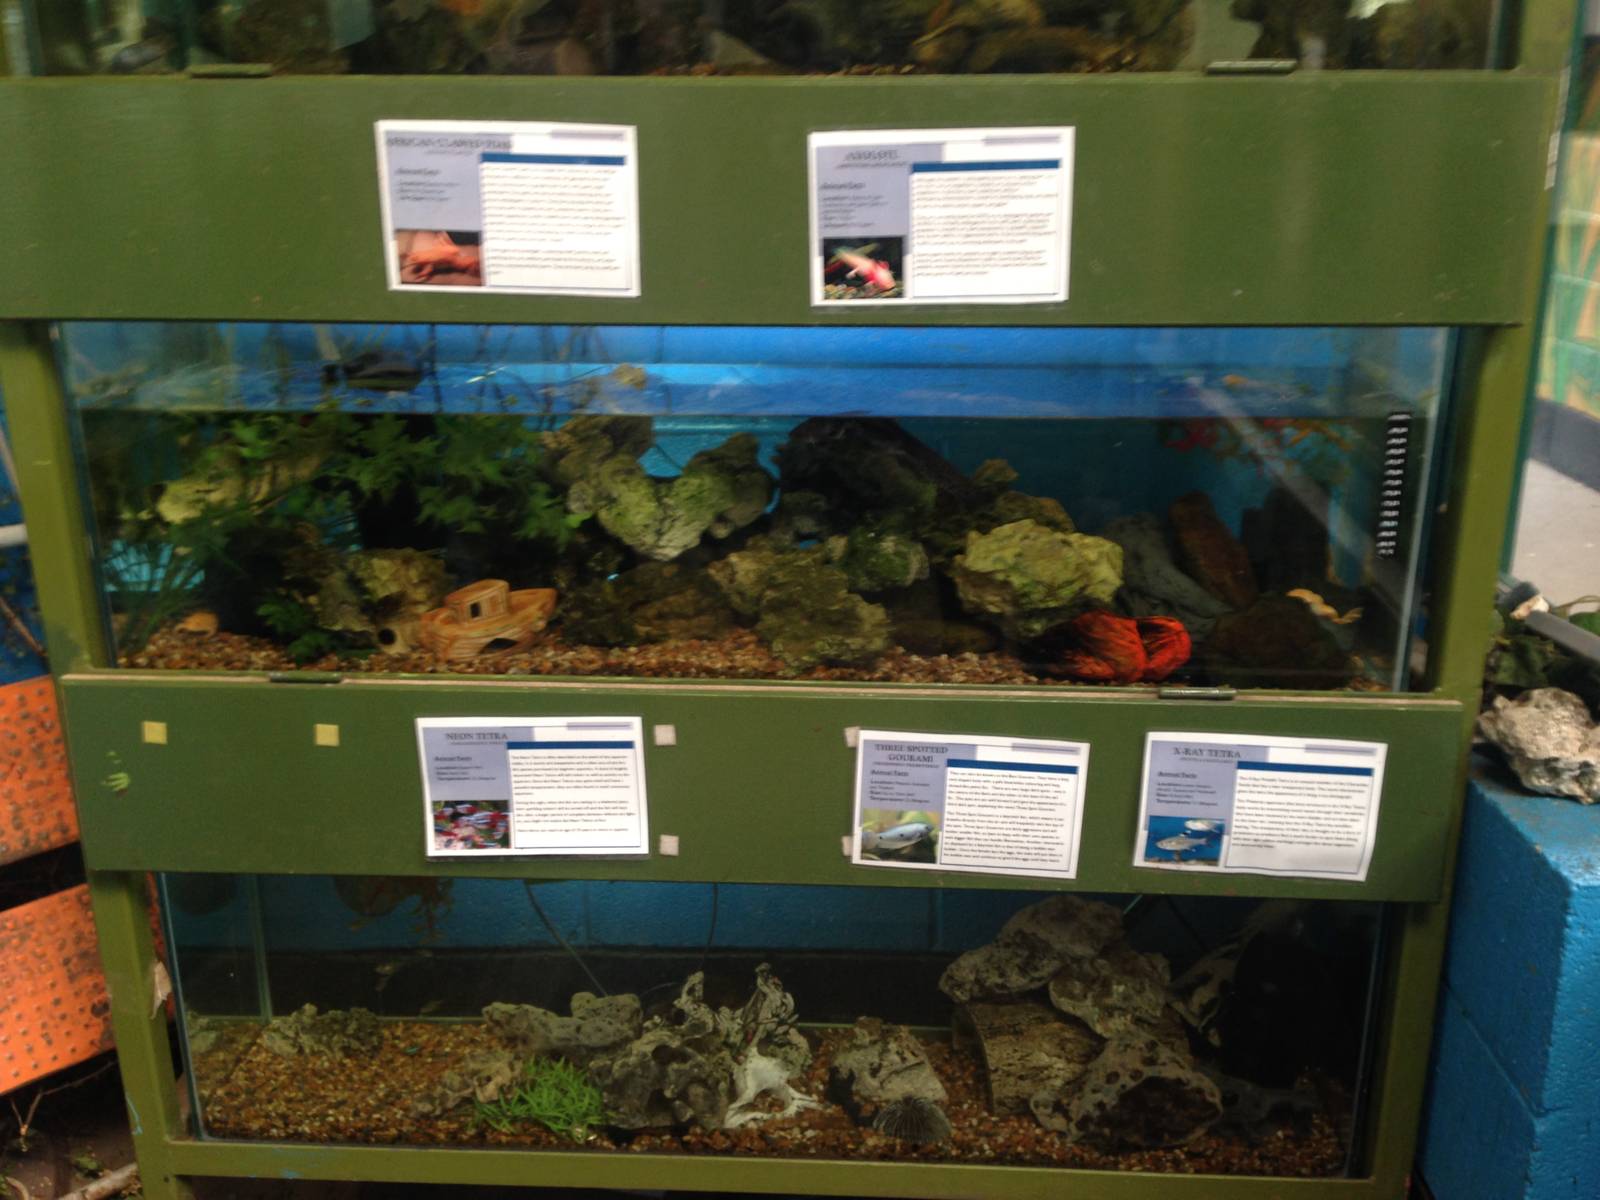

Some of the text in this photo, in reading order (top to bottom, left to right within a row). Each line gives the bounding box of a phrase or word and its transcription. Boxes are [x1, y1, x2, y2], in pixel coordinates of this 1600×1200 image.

[445, 732, 509, 741] NEON TETRA
[874, 743, 949, 754] THREE SPOTTED
[1173, 747, 1241, 758] X-RAY TETRA
[888, 753, 934, 763] GOURAMI
